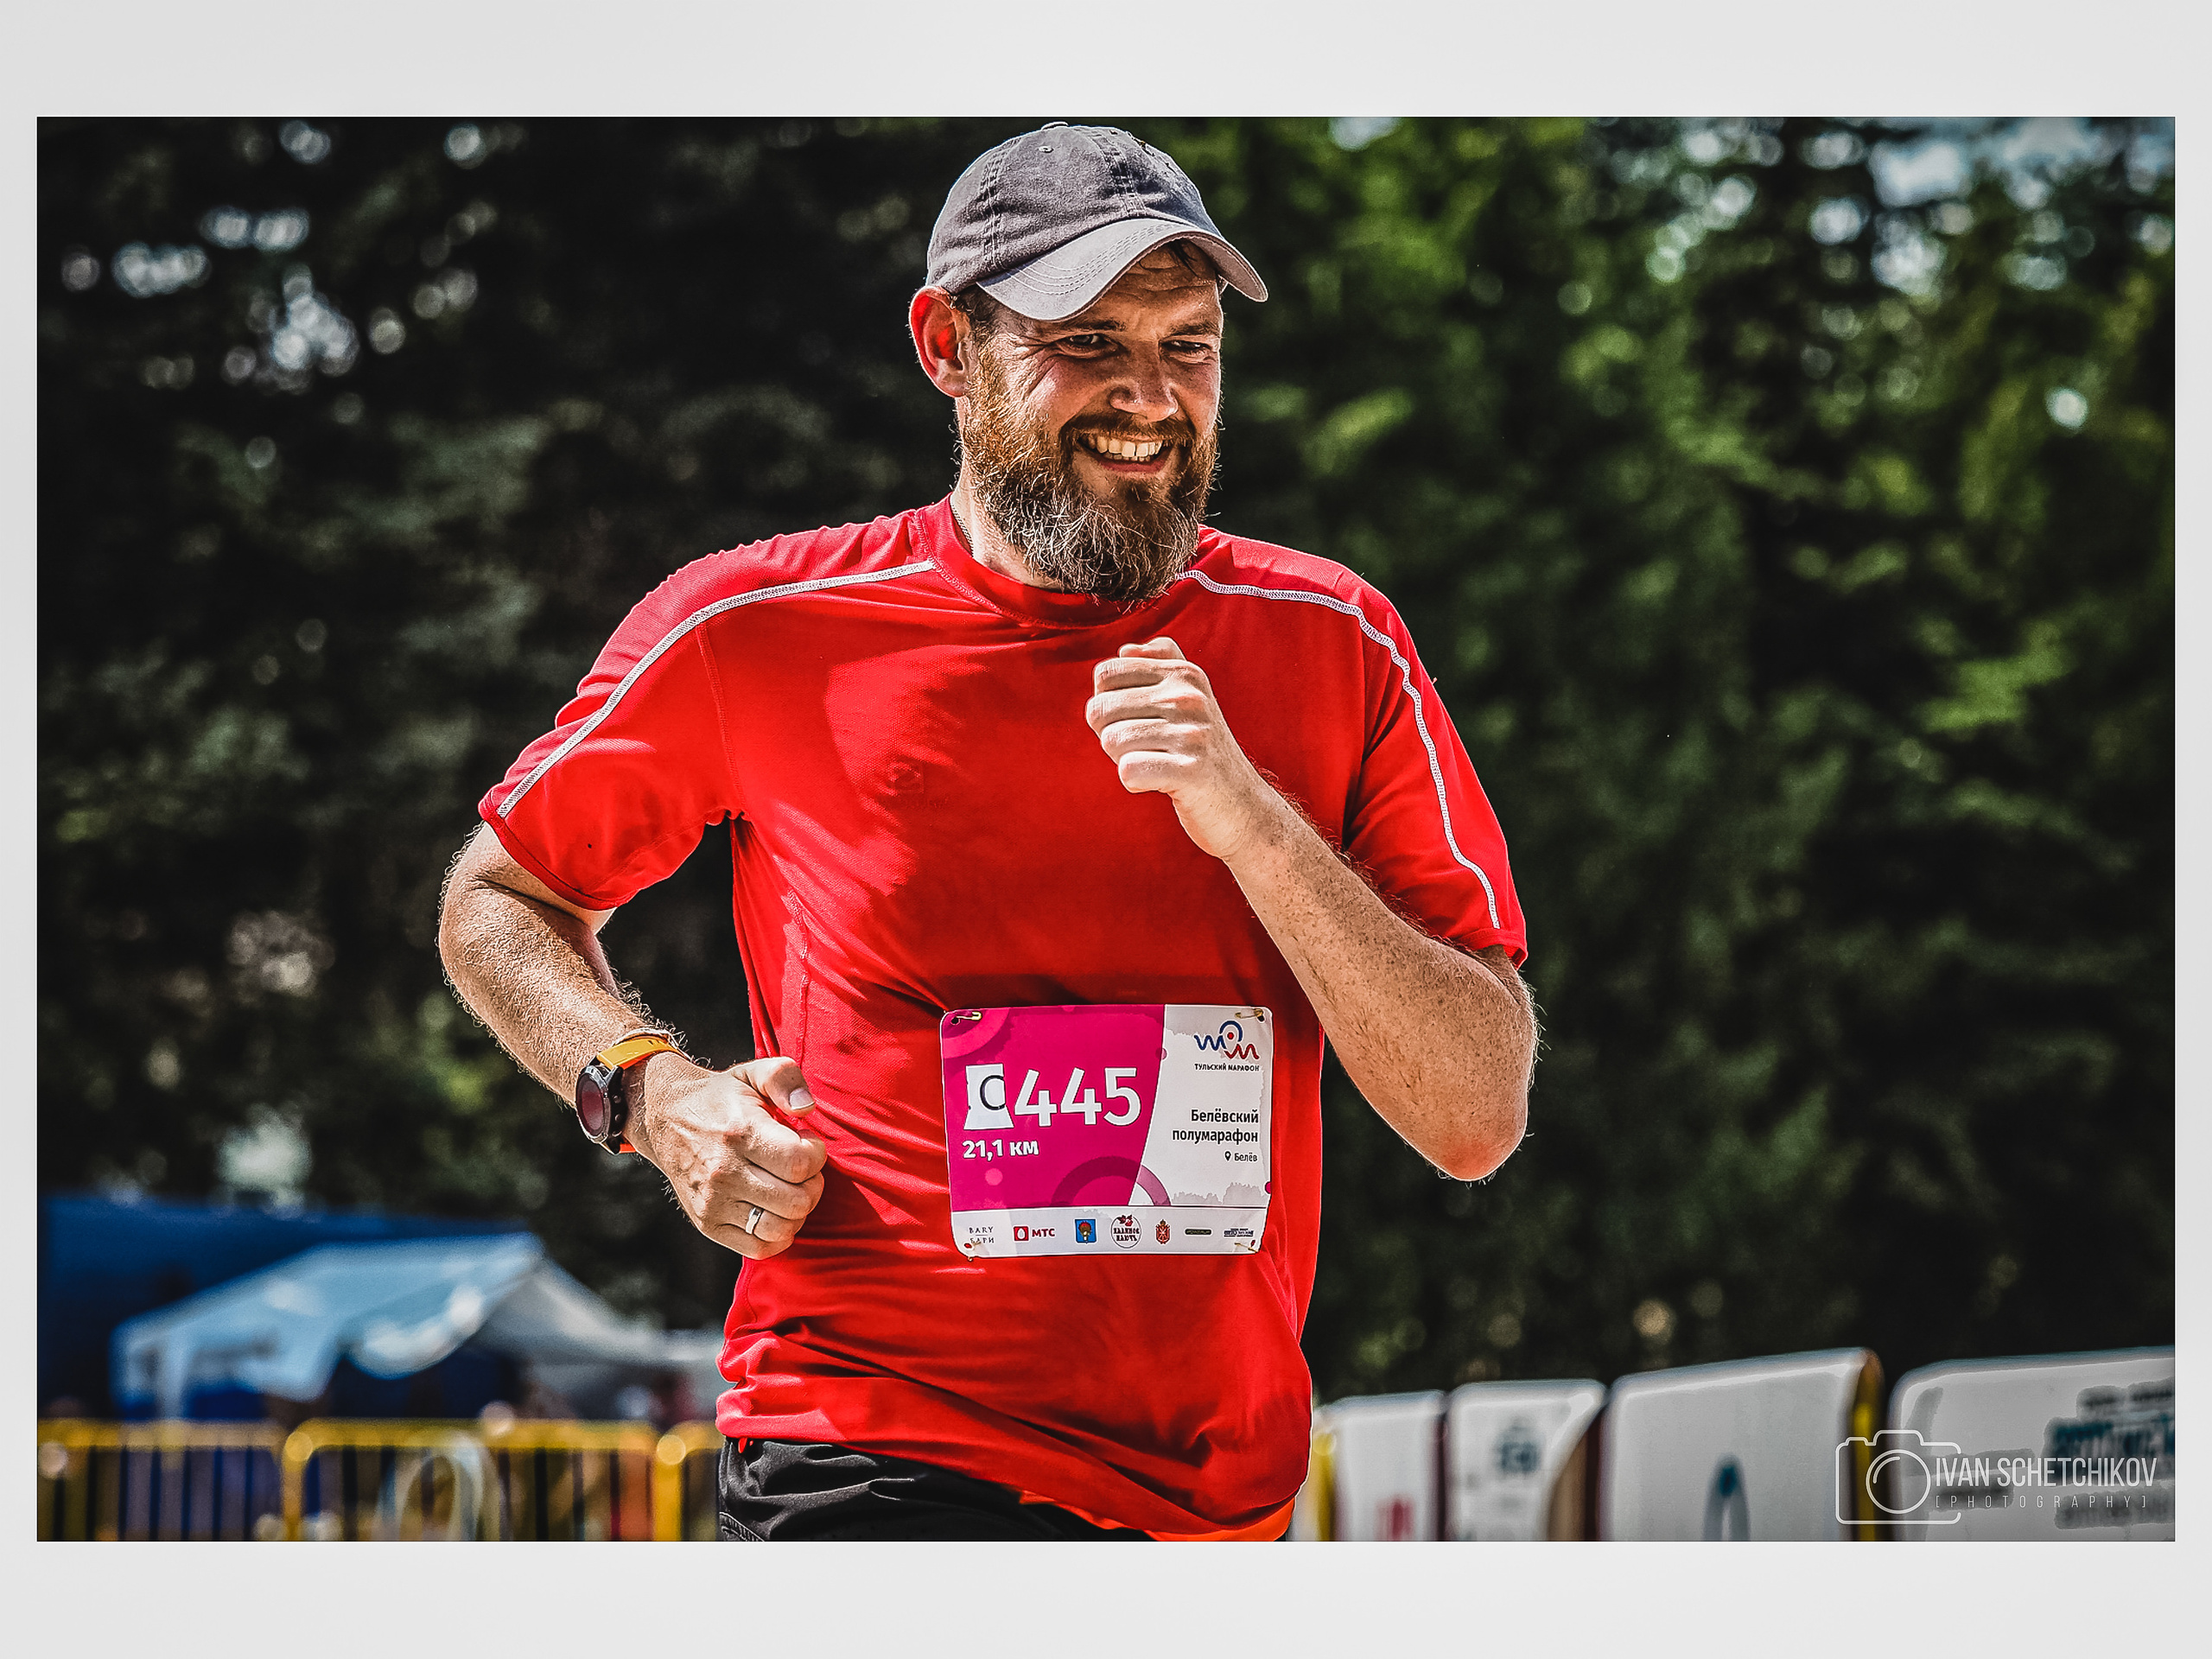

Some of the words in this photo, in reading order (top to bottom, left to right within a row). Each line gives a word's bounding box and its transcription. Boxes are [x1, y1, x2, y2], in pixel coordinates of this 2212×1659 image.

[1194, 1063, 1227, 1071] ТУЛЬСКИЙ
[1191, 1108, 1259, 1123] Белёвский
[1172, 1128, 1258, 1145] полумарафон
[962, 1139, 1003, 1161] 21,1
[1234, 1152, 1258, 1162] Белёв
